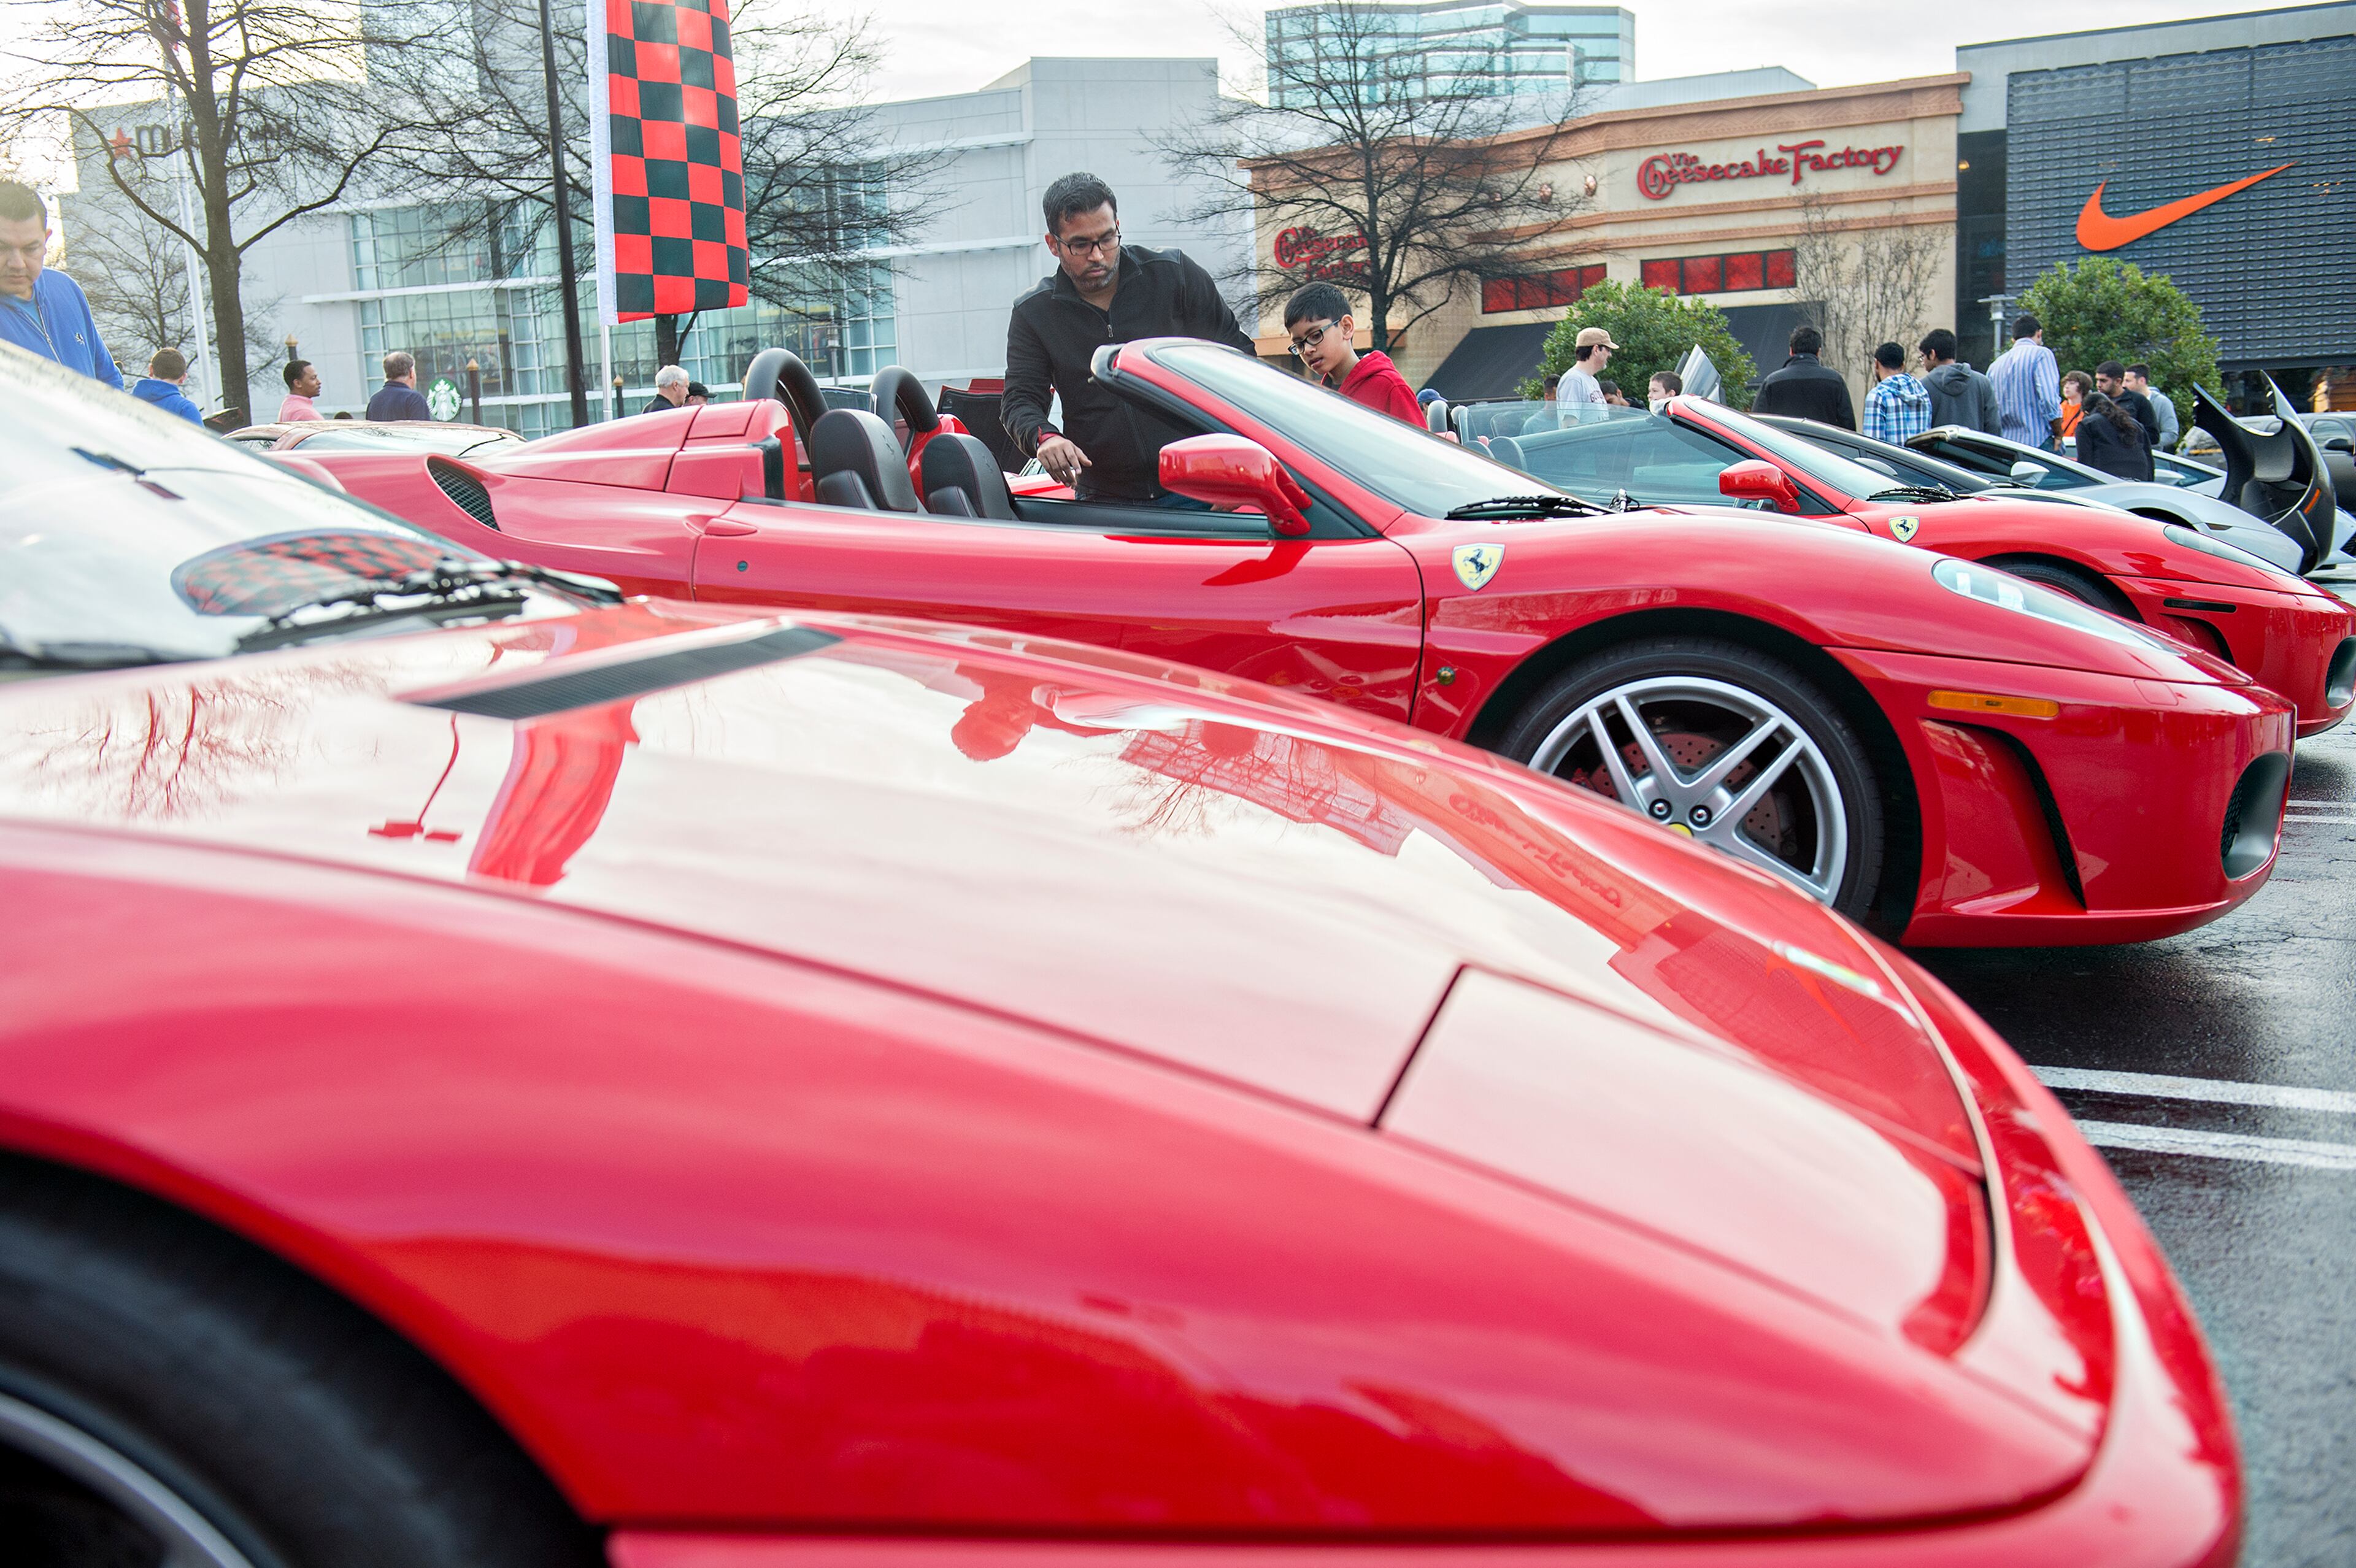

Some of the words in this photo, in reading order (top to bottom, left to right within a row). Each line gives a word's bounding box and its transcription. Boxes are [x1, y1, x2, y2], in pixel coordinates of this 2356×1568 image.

[1638, 148, 1788, 200] Cheesecake
[1673, 153, 1699, 166] The
[1778, 140, 1904, 185] Factory
